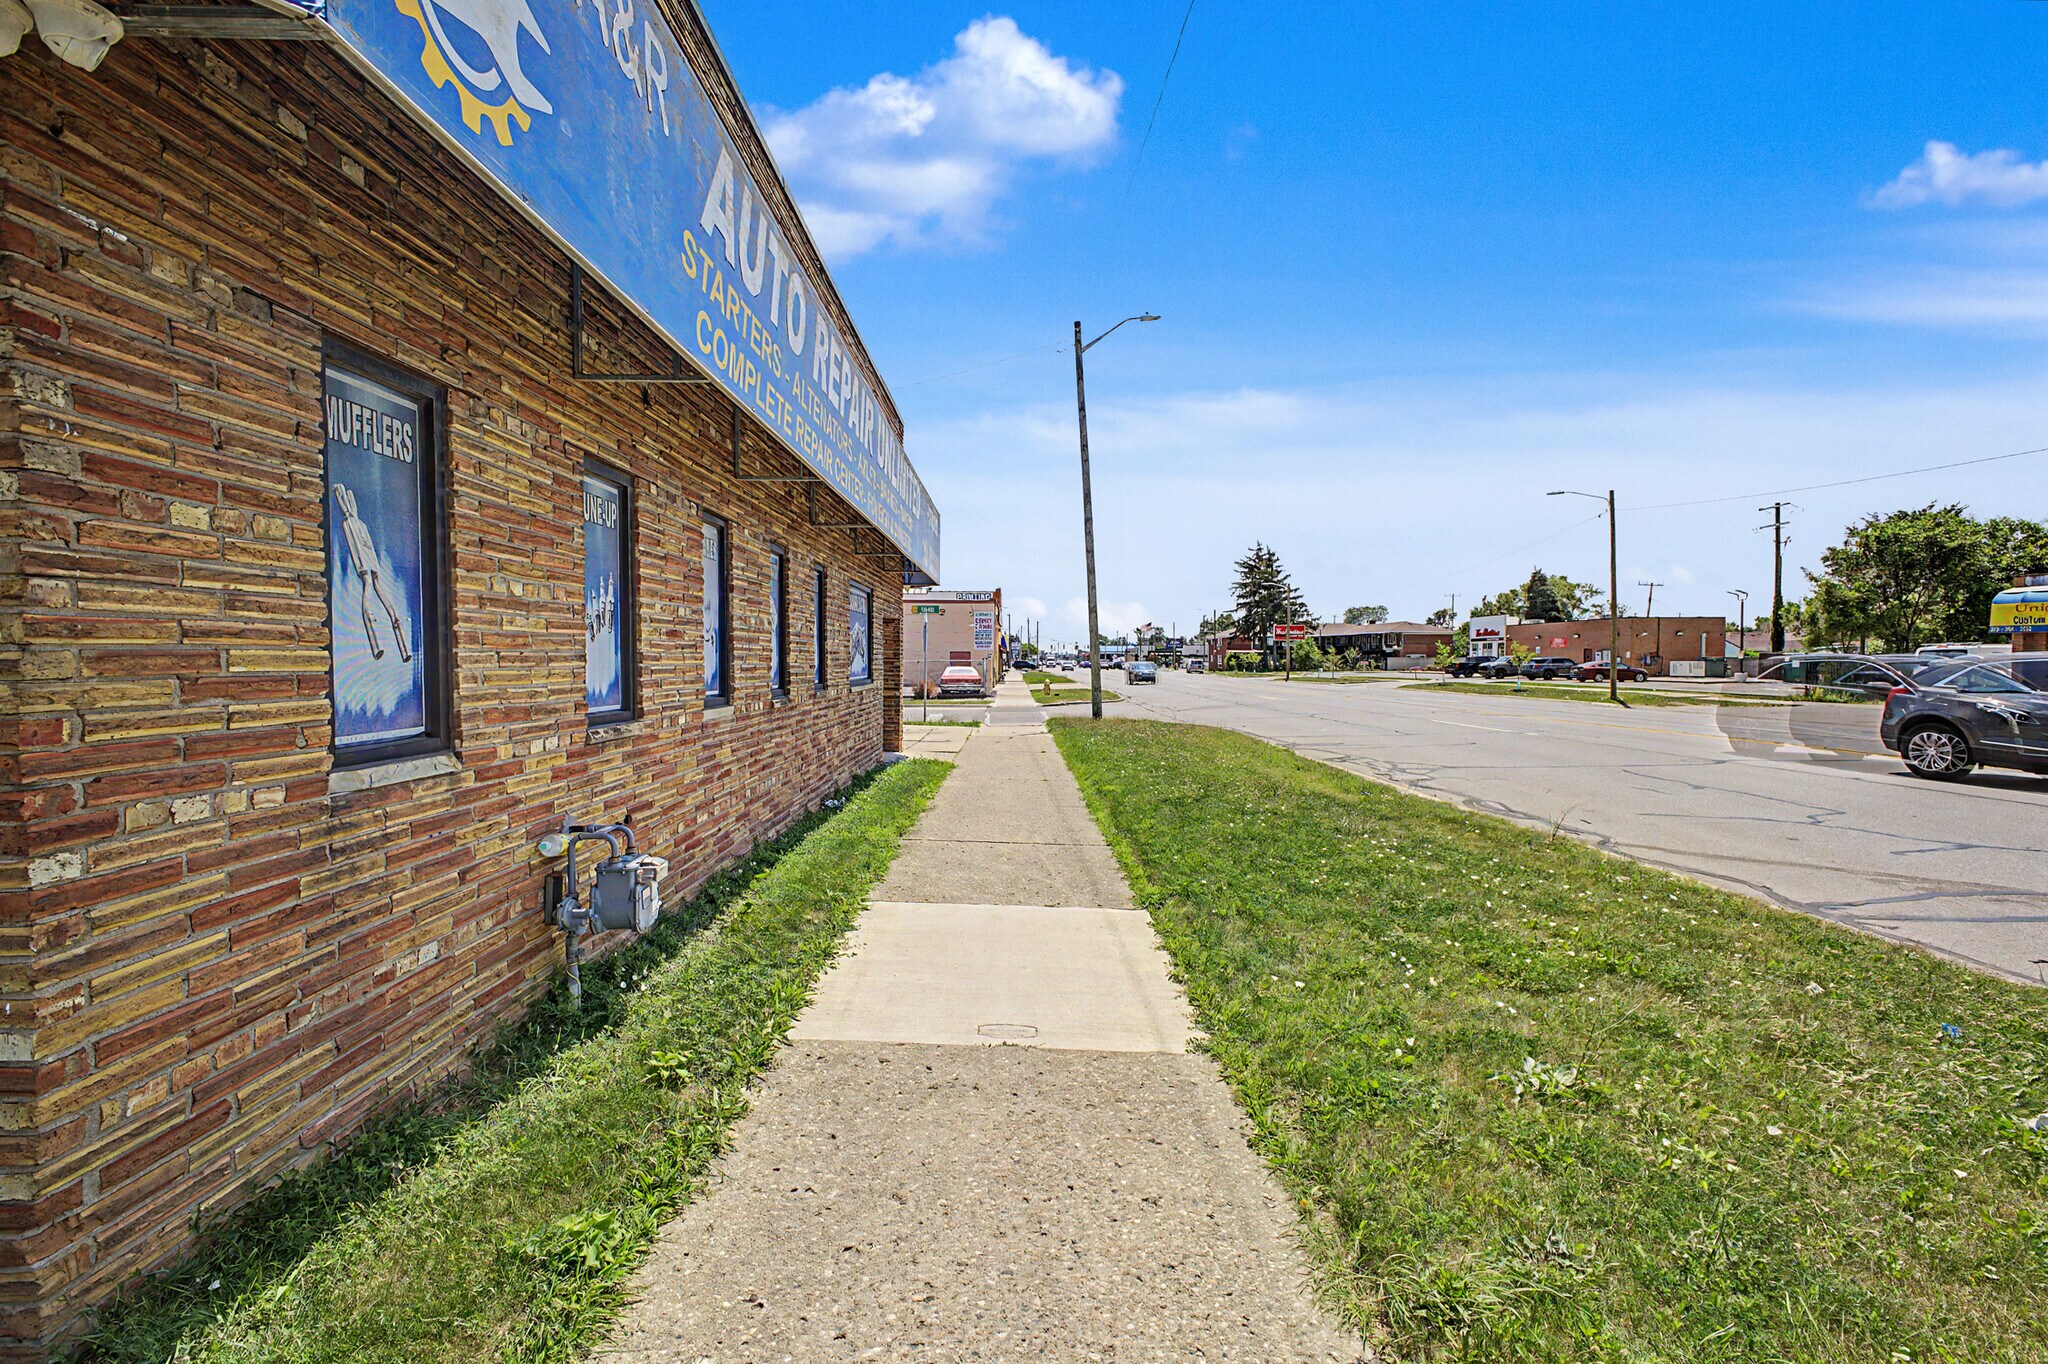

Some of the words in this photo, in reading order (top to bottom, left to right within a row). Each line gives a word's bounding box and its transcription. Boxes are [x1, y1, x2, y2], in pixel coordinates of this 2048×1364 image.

[681, 229, 782, 379] STARTERS
[792, 371, 853, 462] ALTENATORS
[700, 147, 806, 357] AUTO
[813, 310, 876, 458] REPAIR
[325, 393, 413, 464] MUFFLERS
[696, 310, 793, 437] COMPLETE
[795, 414, 833, 476] REPAIR
[583, 491, 618, 529] UNE-UP
